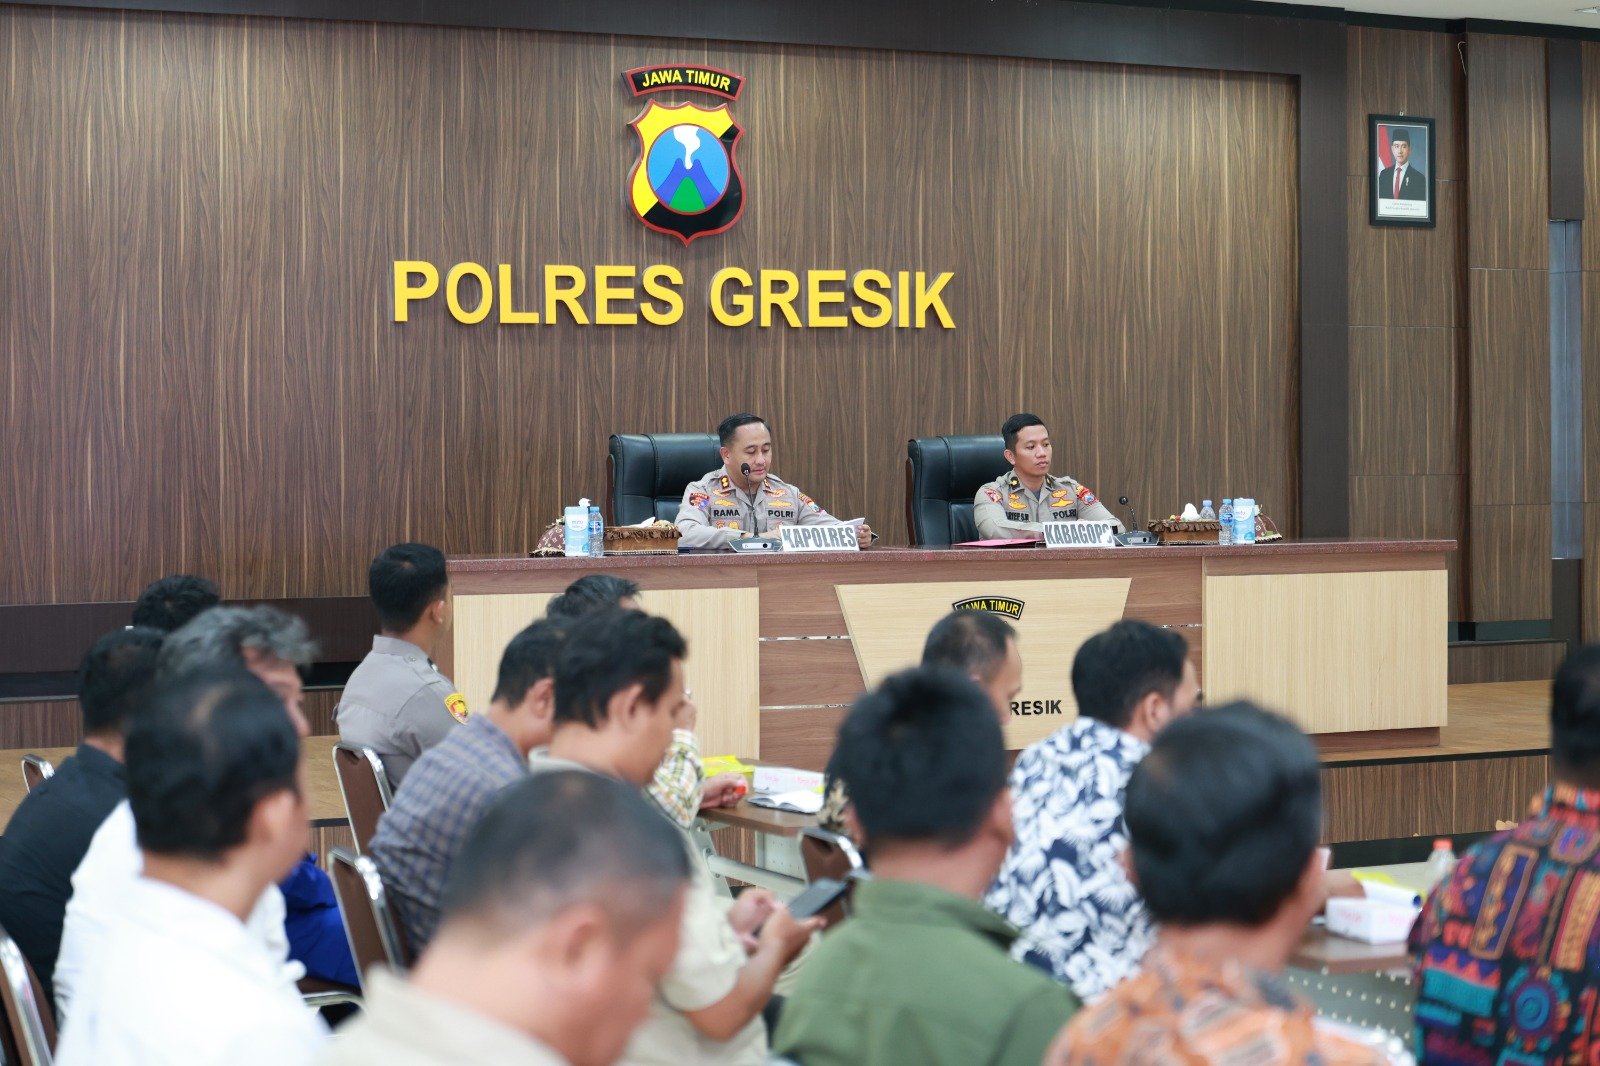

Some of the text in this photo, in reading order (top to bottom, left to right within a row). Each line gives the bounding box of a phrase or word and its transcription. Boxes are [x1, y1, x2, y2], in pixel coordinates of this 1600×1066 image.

[642, 69, 731, 92] JAWA TIMUR
[392, 260, 956, 330] POLRES GRESIK
[713, 509, 741, 518] RAMA
[767, 509, 794, 519] POLRI
[1052, 508, 1077, 520] POLRI
[781, 526, 857, 549] KAPOLRES
[989, 600, 1019, 615] TIMUR
[1009, 699, 1062, 716] RESIK
